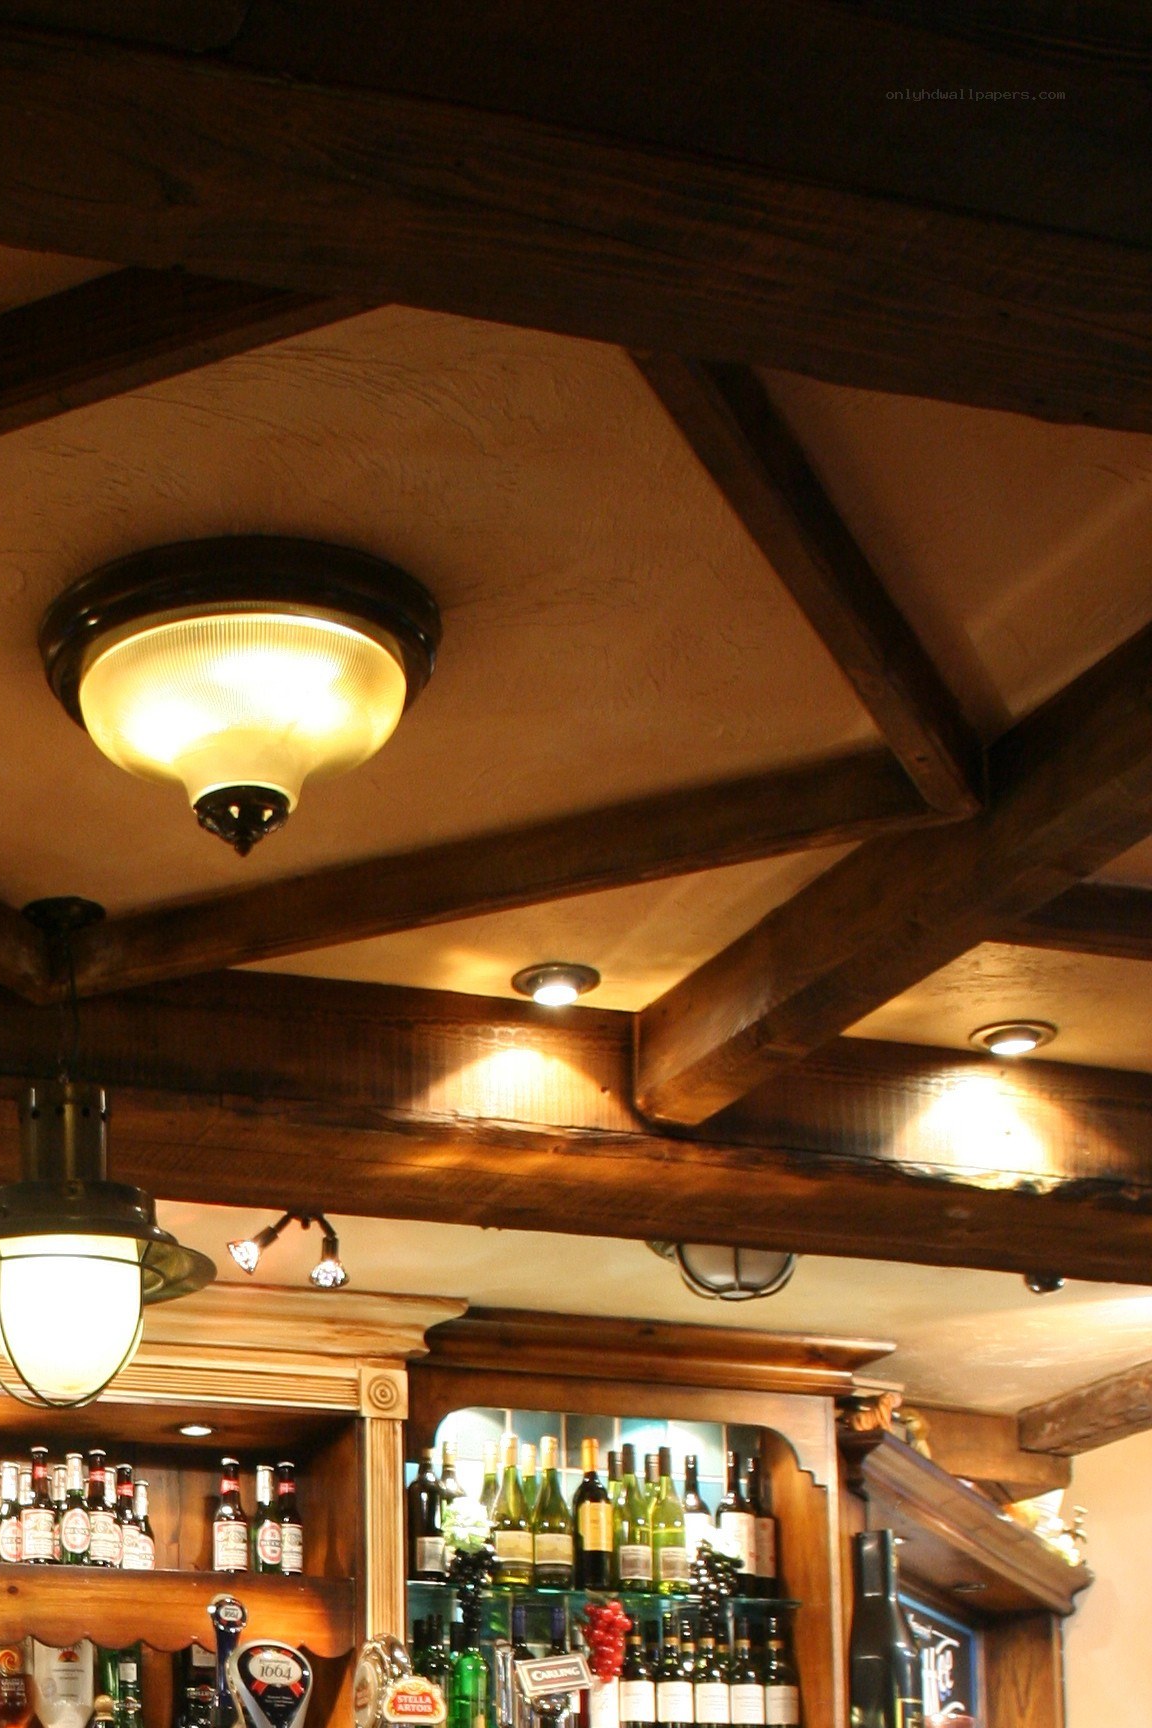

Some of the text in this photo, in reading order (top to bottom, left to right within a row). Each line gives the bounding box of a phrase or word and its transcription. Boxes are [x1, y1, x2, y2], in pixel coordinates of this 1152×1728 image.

[260, 1664, 292, 1681] 1664
[530, 1666, 580, 1682] CARLING
[397, 1694, 432, 1704] STELLA
[397, 1703, 433, 1713] ARTOIS
